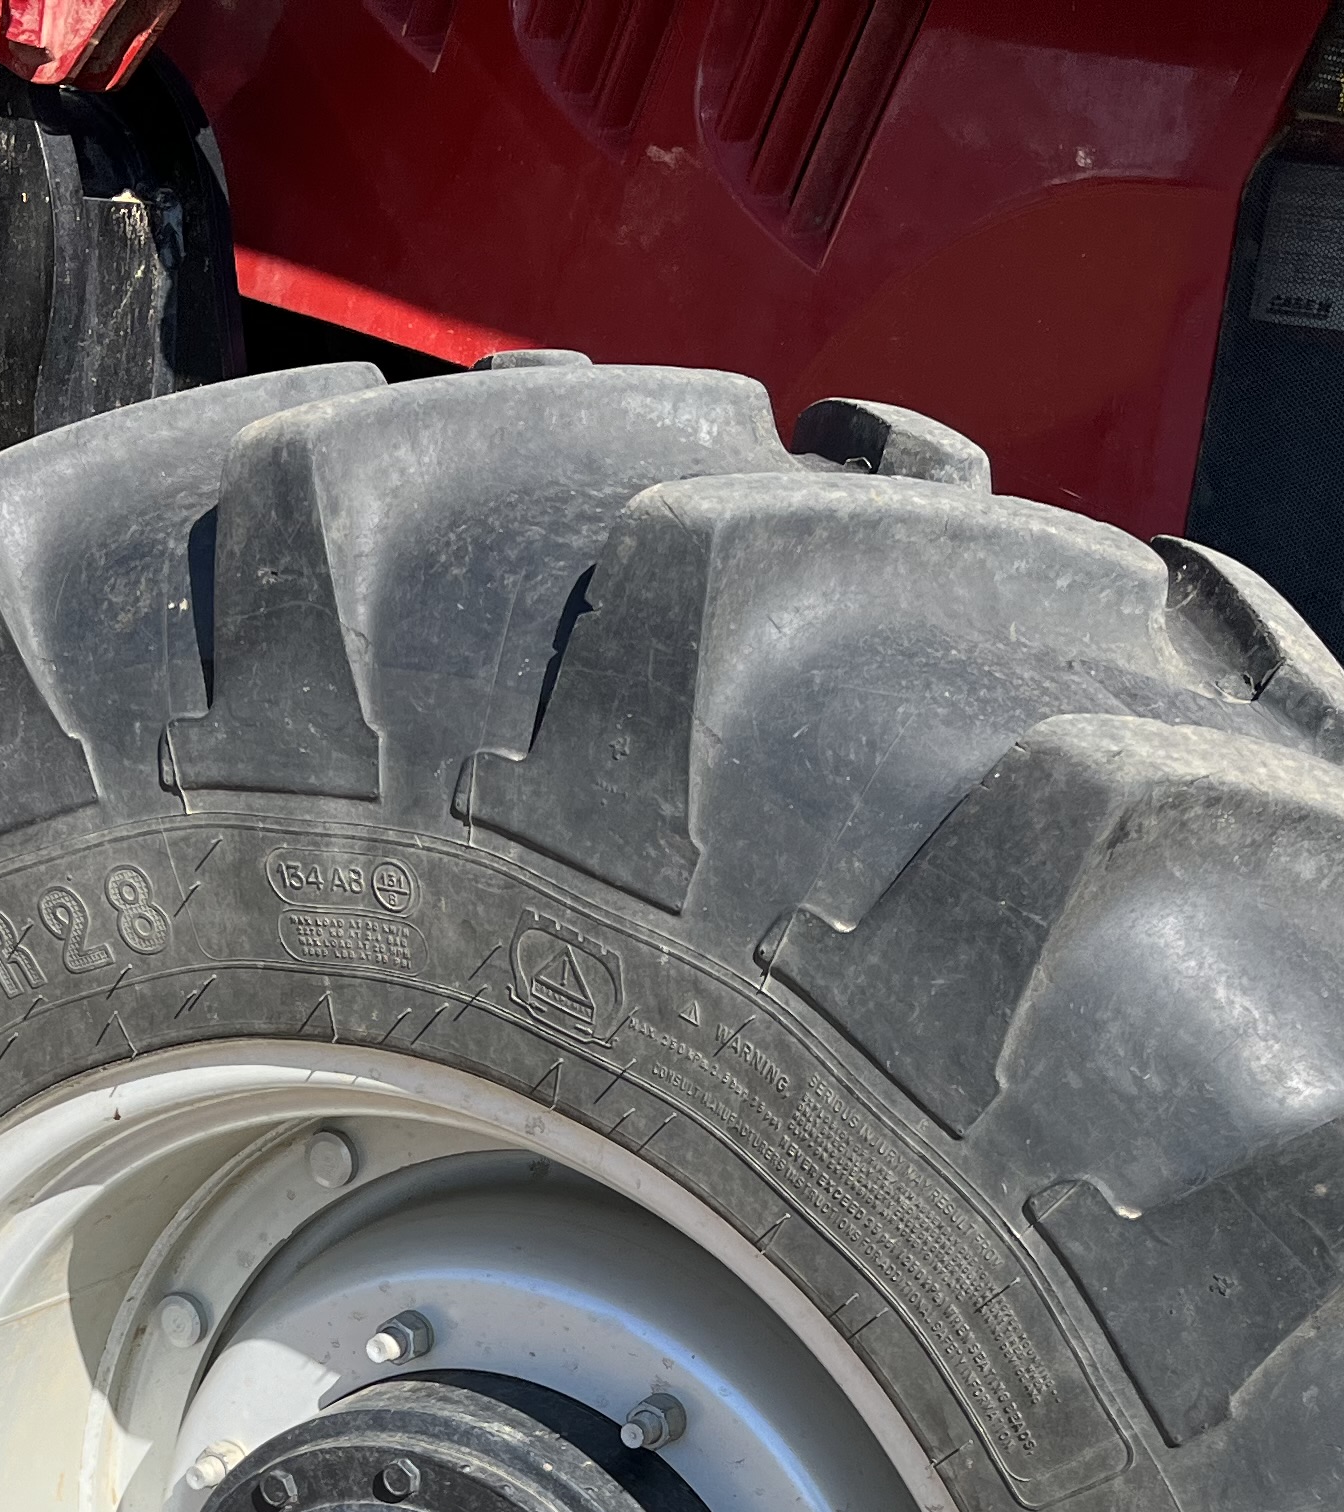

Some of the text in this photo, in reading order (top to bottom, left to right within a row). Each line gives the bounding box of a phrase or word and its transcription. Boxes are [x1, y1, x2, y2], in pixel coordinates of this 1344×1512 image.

[276, 861, 365, 894] 134 A8
[774, 1132, 823, 1180] NEVER
[813, 1169, 868, 1223] EXCEED
[805, 1071, 1006, 1271] SERIOUS INJURY MAY RESULT FROM
